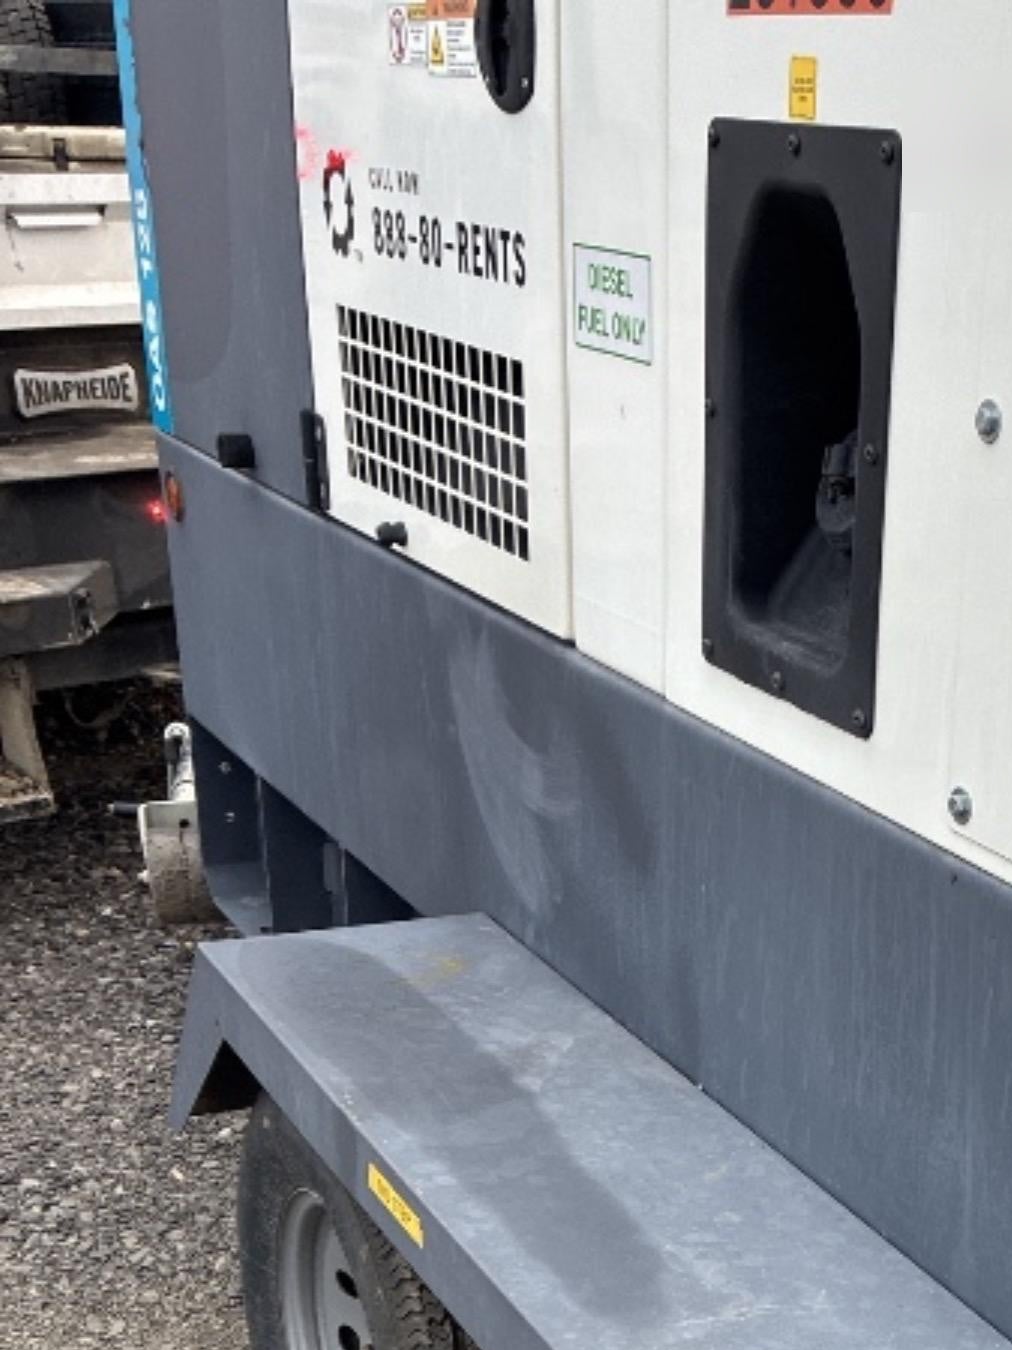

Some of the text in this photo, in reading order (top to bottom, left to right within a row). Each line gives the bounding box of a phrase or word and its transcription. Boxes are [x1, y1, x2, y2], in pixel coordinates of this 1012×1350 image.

[372, 205, 526, 289] 888-80-RENTS
[588, 263, 634, 298] DIESEL
[612, 311, 646, 346] ONLY
[20, 371, 134, 410] KNAPHEIDE
